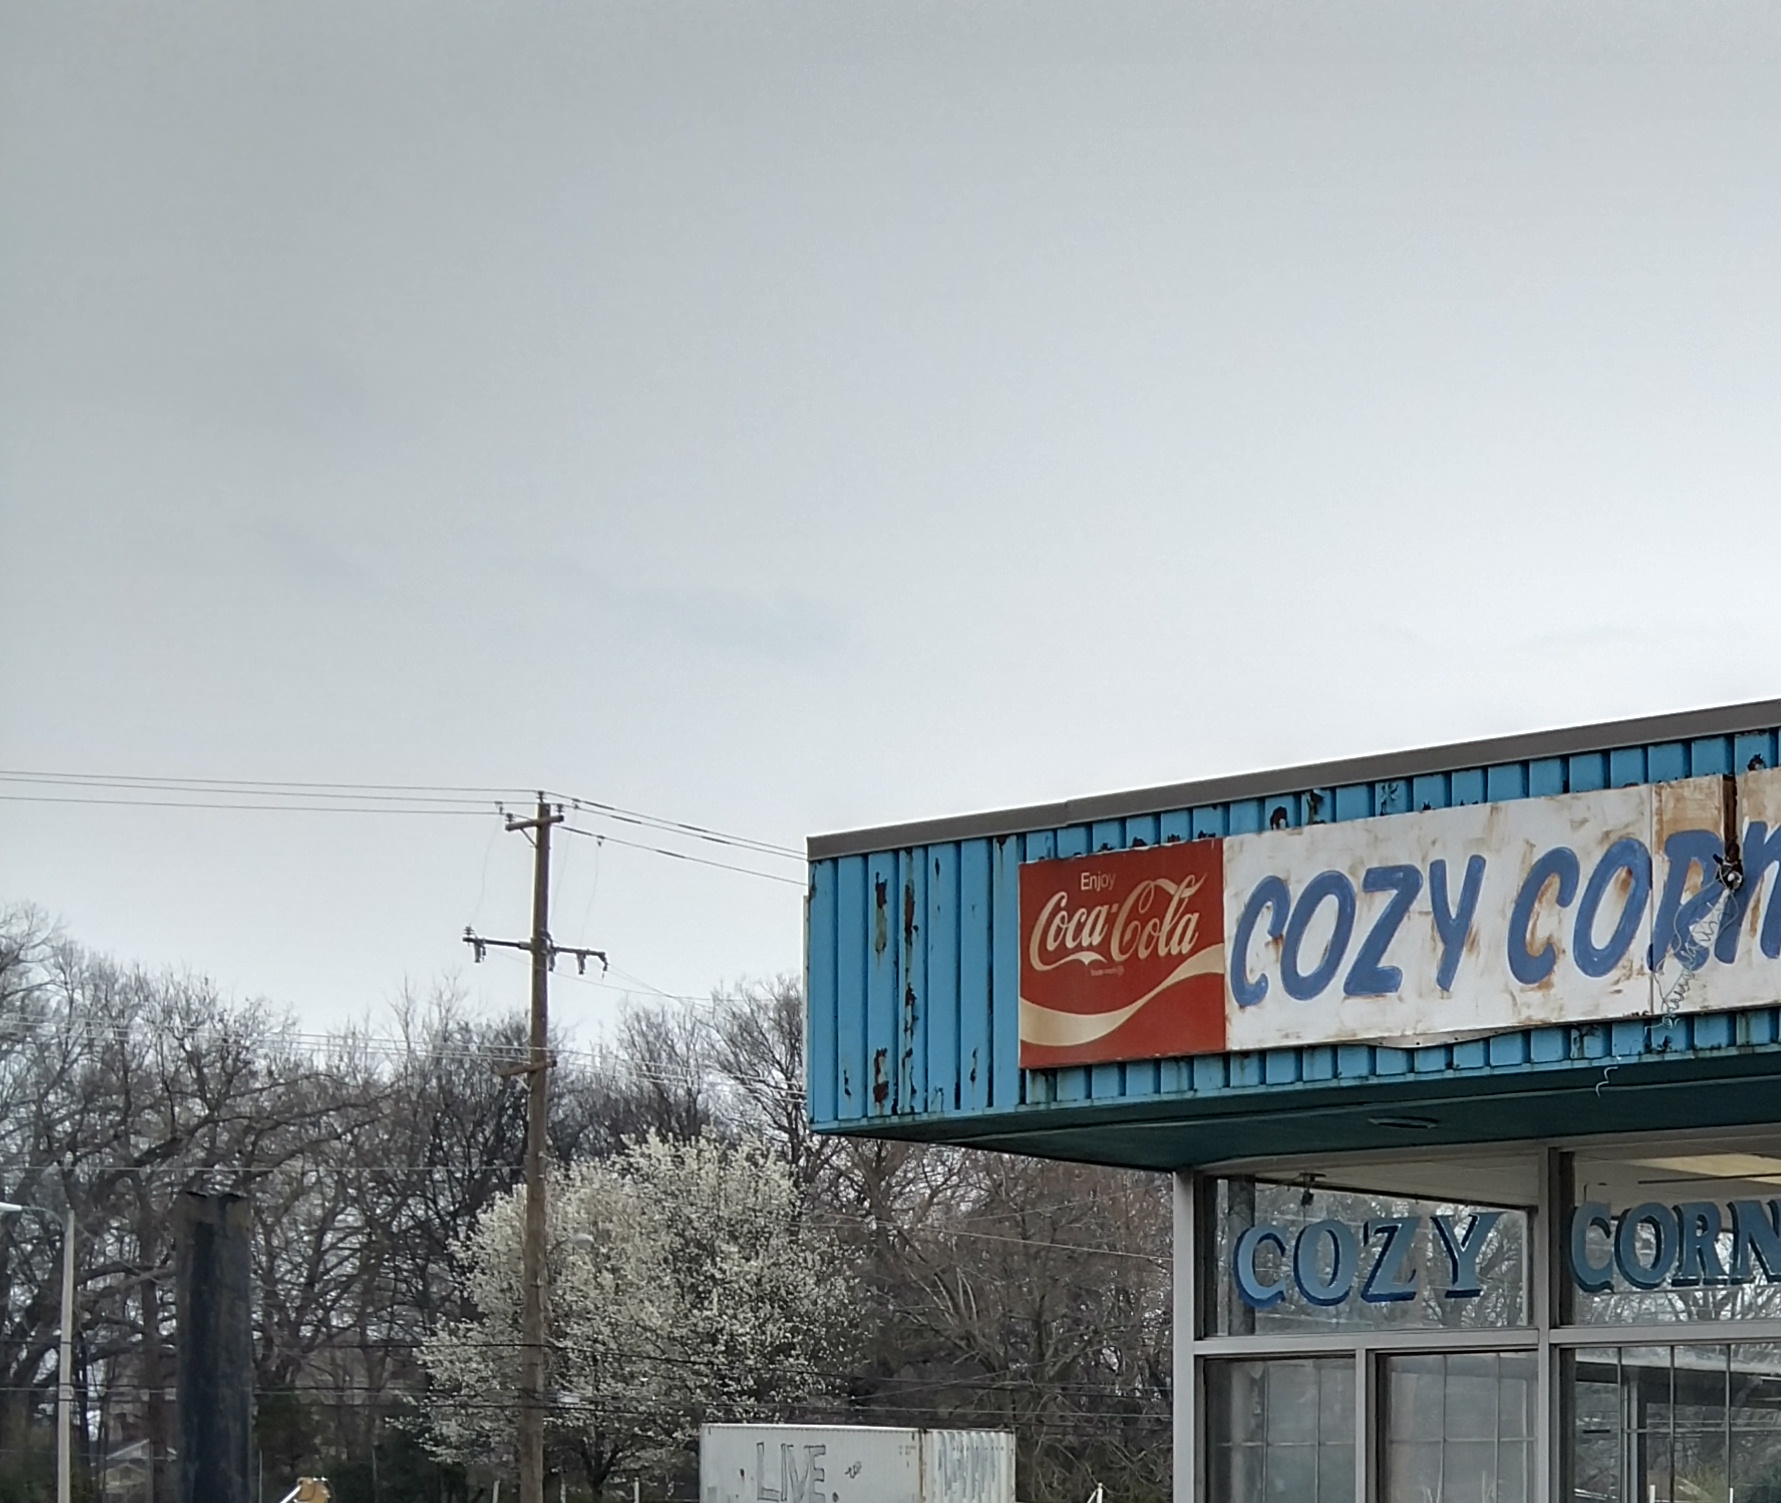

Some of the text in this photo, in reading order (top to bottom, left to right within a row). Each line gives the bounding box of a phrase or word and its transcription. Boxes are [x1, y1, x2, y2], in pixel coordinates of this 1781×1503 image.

[1029, 872, 1208, 972] Coca-Cola
[1080, 872, 1116, 892] Enjoy
[1230, 854, 1487, 1007] COZY
[1232, 1211, 1502, 1308] COZY
